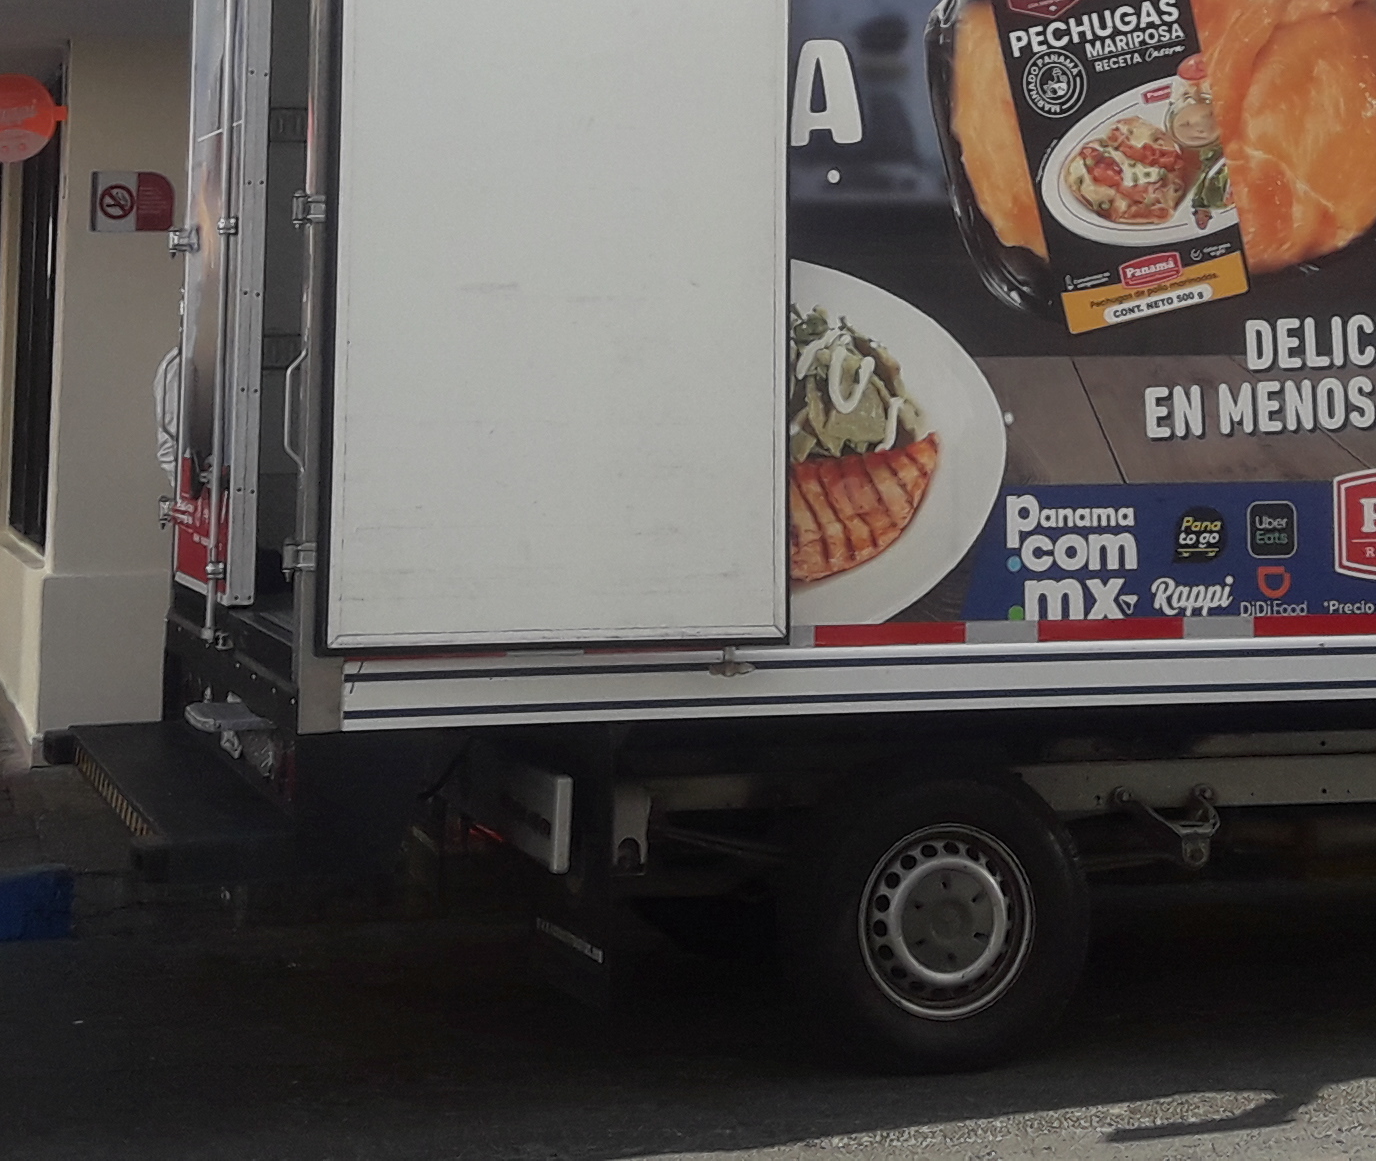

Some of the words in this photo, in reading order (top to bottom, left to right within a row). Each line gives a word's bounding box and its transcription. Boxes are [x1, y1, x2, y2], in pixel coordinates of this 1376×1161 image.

[1084, 22, 1185, 59] MARIPOSA
[1094, 54, 1142, 73] RECETA
[1125, 257, 1176, 279] Panamá
[1146, 296, 1174, 311] NETO
[1176, 291, 1195, 304] 500
[1144, 384, 1206, 439] EN
[1180, 516, 1222, 532] Pana
[1254, 516, 1288, 530] Uber
[1178, 532, 1197, 545] to
[1199, 532, 1220, 548] go
[1254, 531, 1289, 545] Eats
[1150, 575, 1237, 617] Rappi
